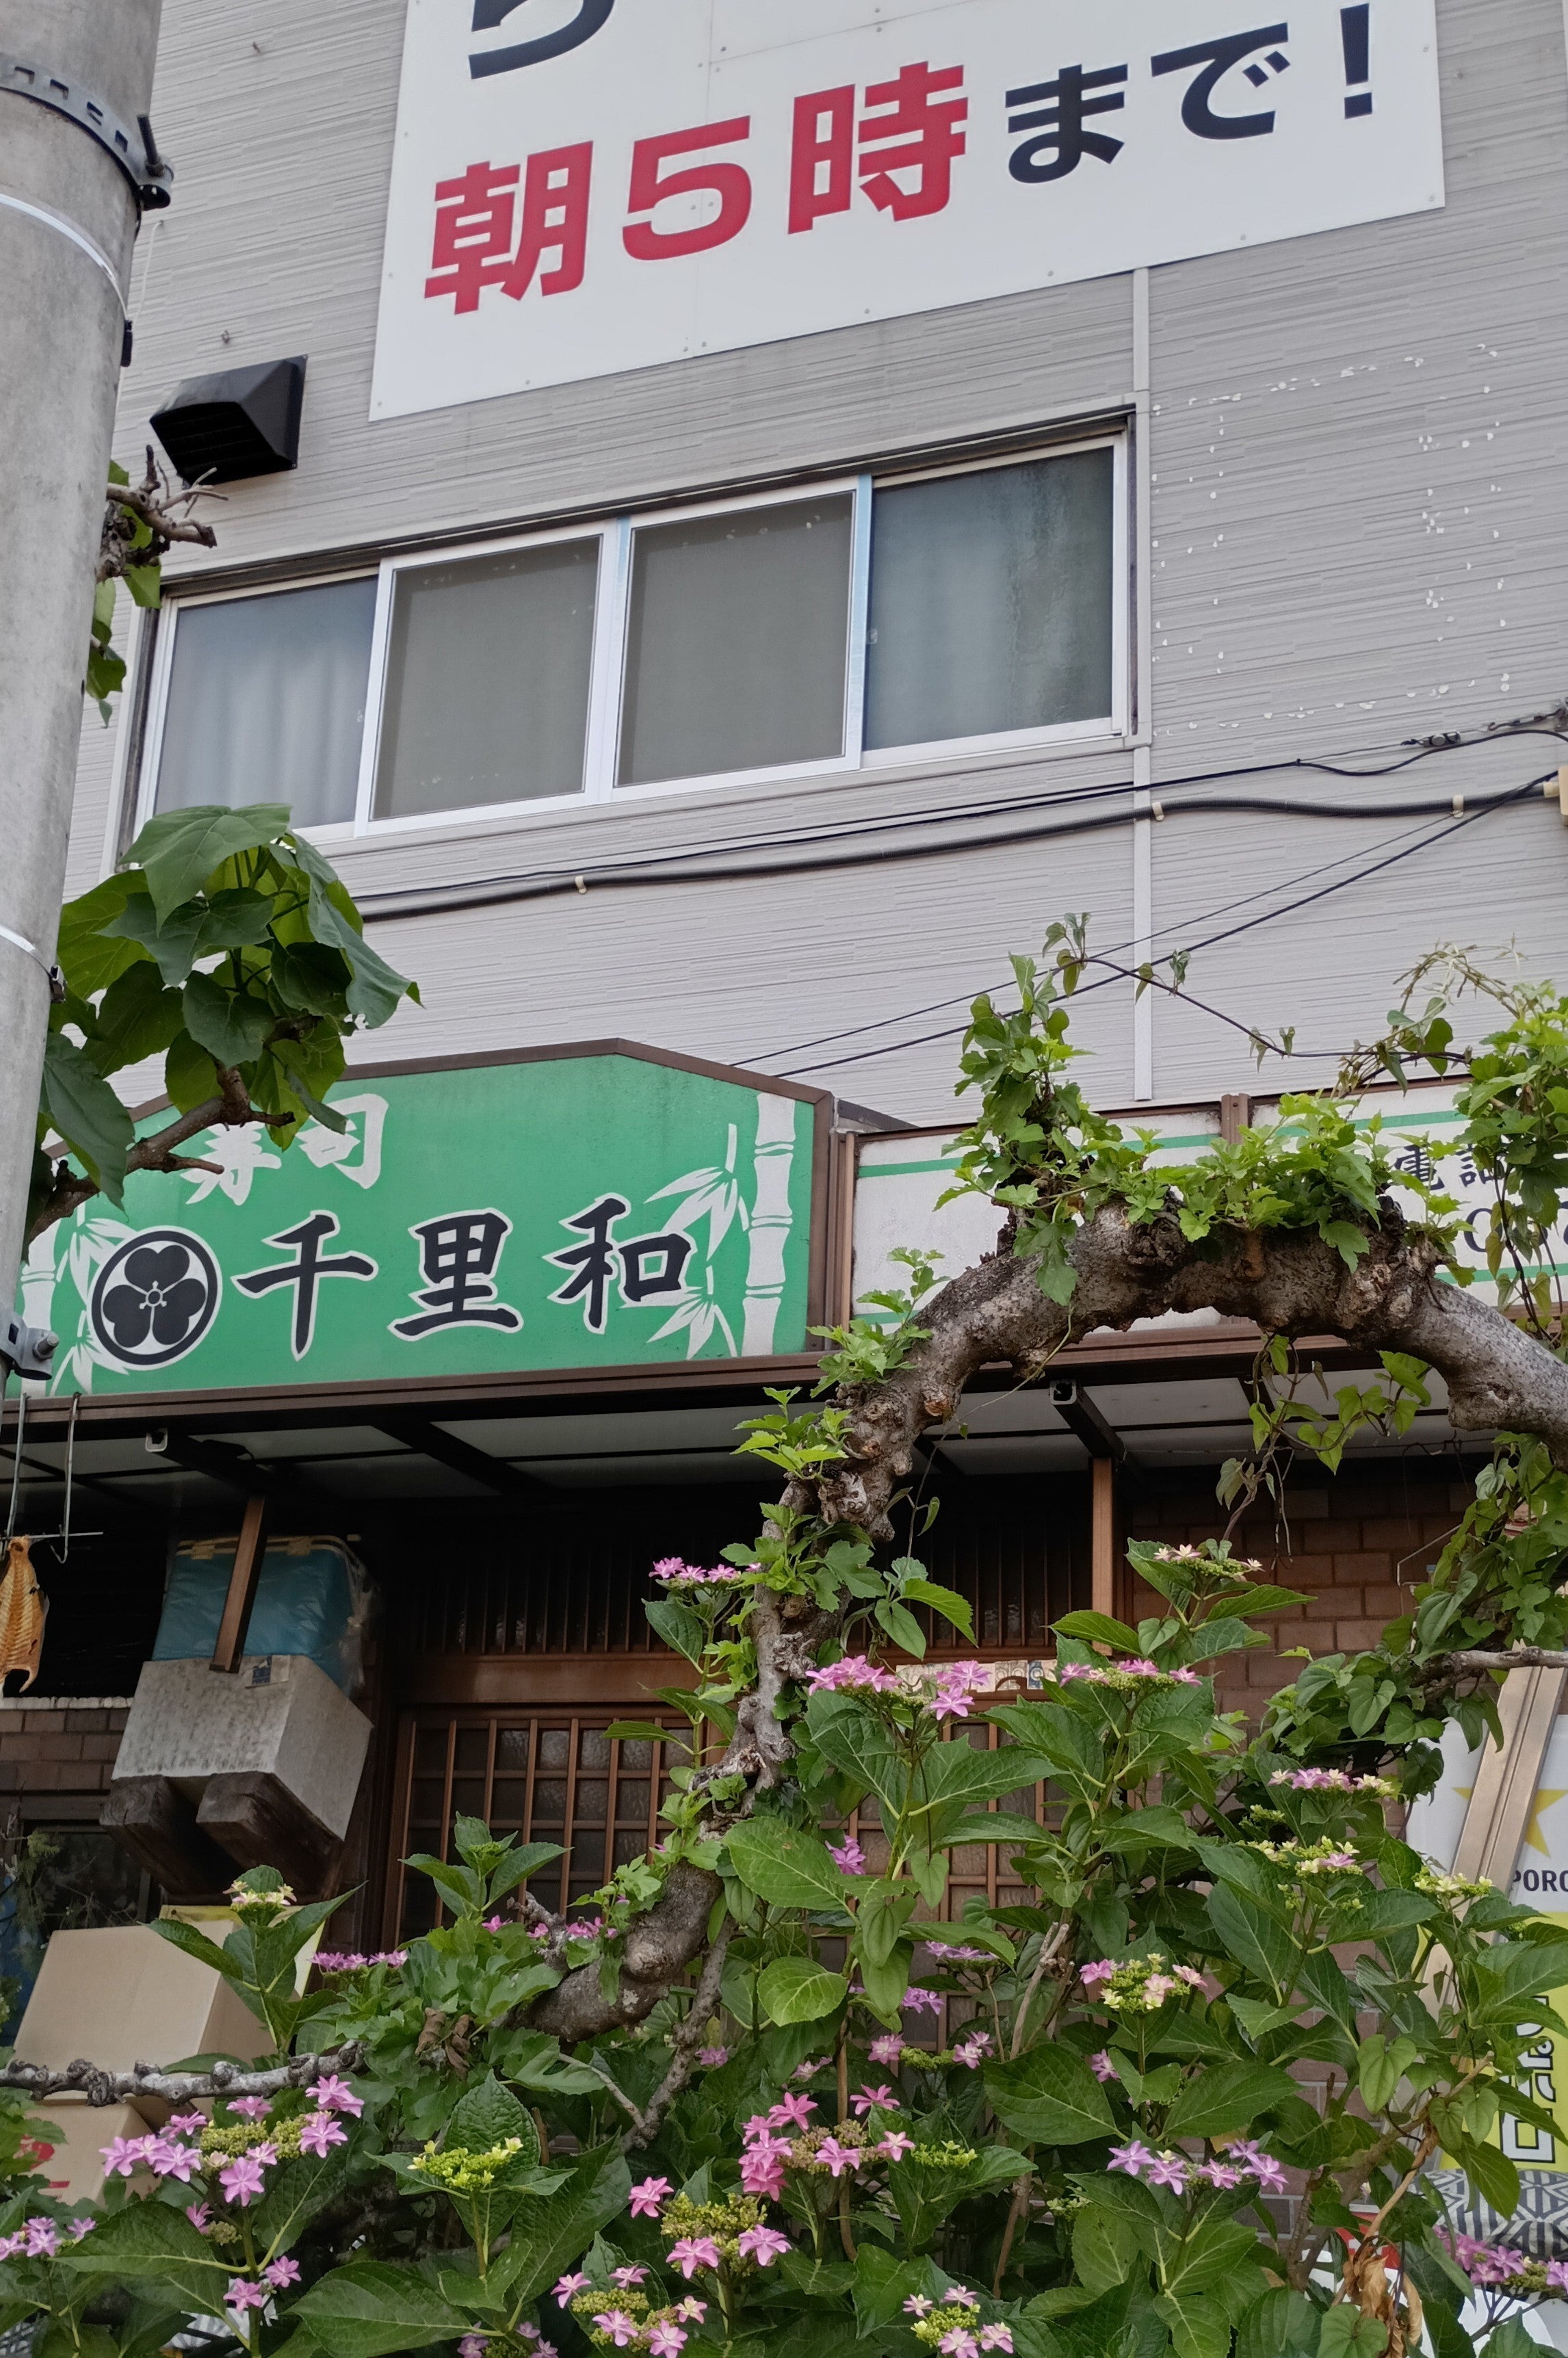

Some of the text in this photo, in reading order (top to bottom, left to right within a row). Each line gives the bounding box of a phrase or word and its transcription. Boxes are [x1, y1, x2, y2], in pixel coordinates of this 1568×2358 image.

[426, 4, 1372, 313] 朝5時まで!
[236, 1194, 694, 1357] 千里和
